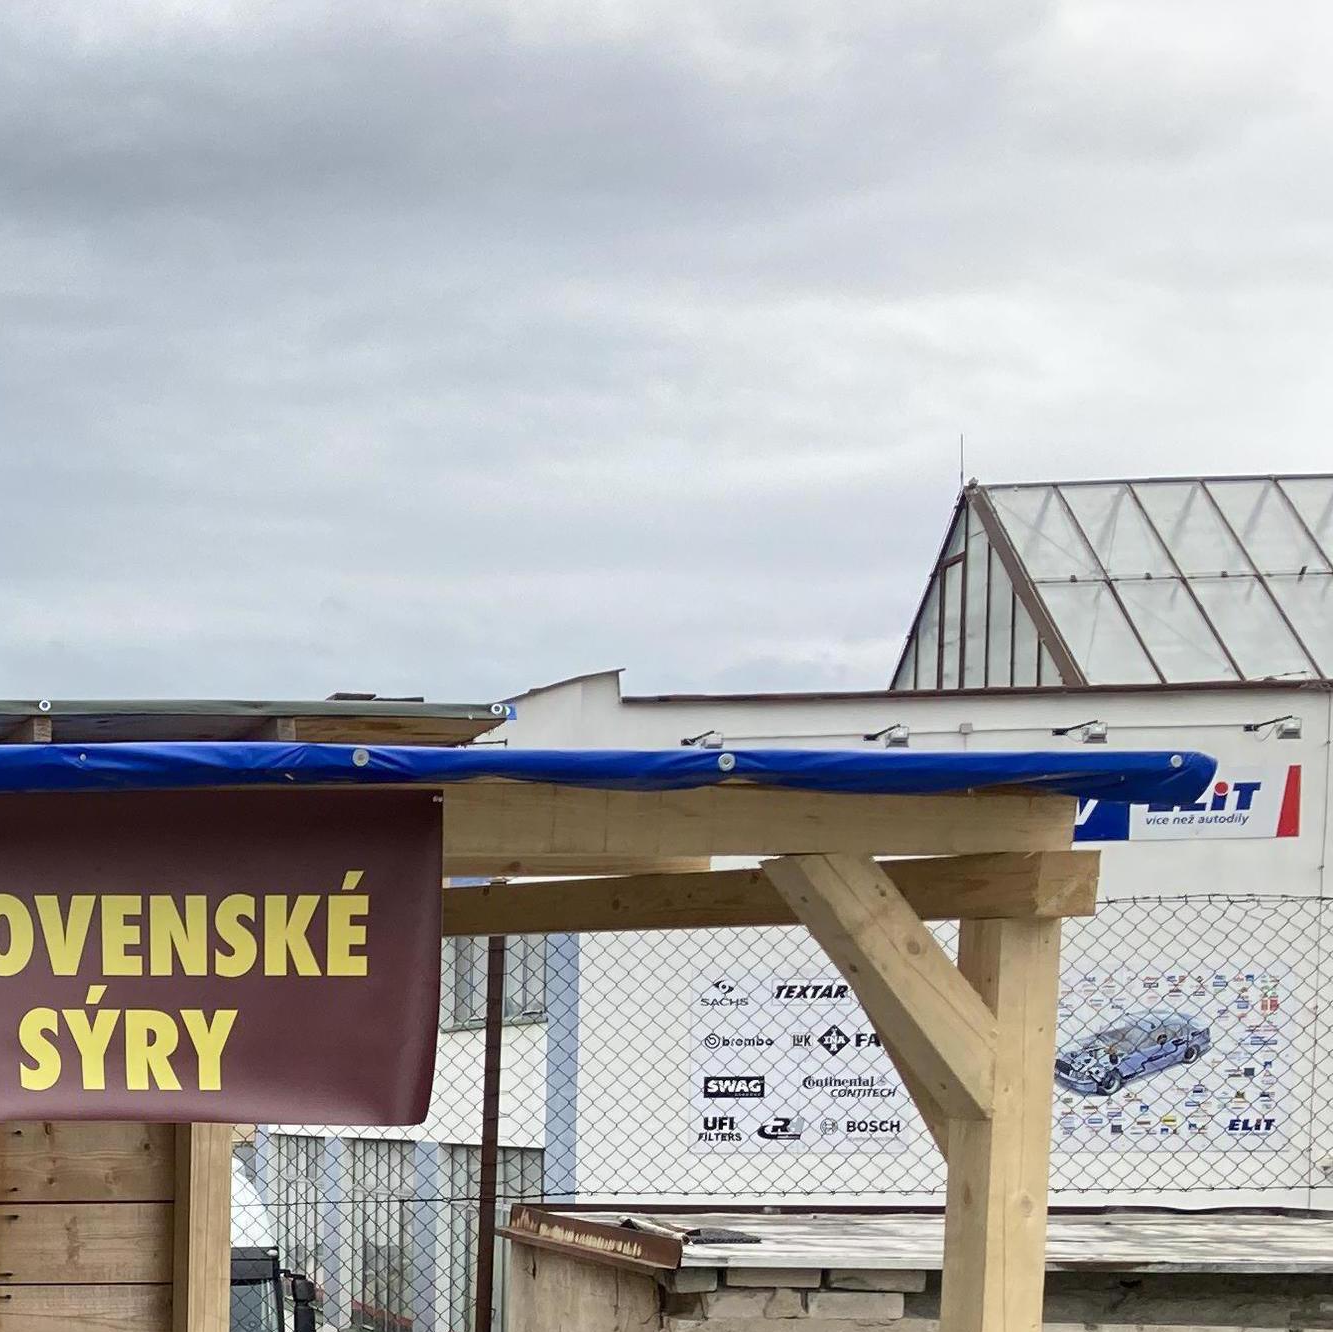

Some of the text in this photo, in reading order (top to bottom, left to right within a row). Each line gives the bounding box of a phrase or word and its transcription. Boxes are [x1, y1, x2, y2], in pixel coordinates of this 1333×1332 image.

[1172, 813, 1195, 825] než
[774, 984, 849, 1000] TEXTAR
[701, 997, 749, 1007] SACHS
[18, 984, 238, 1091] SÝRY
[722, 1033, 775, 1048] brembo
[855, 1033, 883, 1048] FA
[707, 1080, 762, 1093] SWAG
[802, 1076, 875, 1089] Continental
[703, 1117, 735, 1130] UFI
[846, 1121, 901, 1133] BOSCH
[698, 1132, 742, 1142] FILTERS
